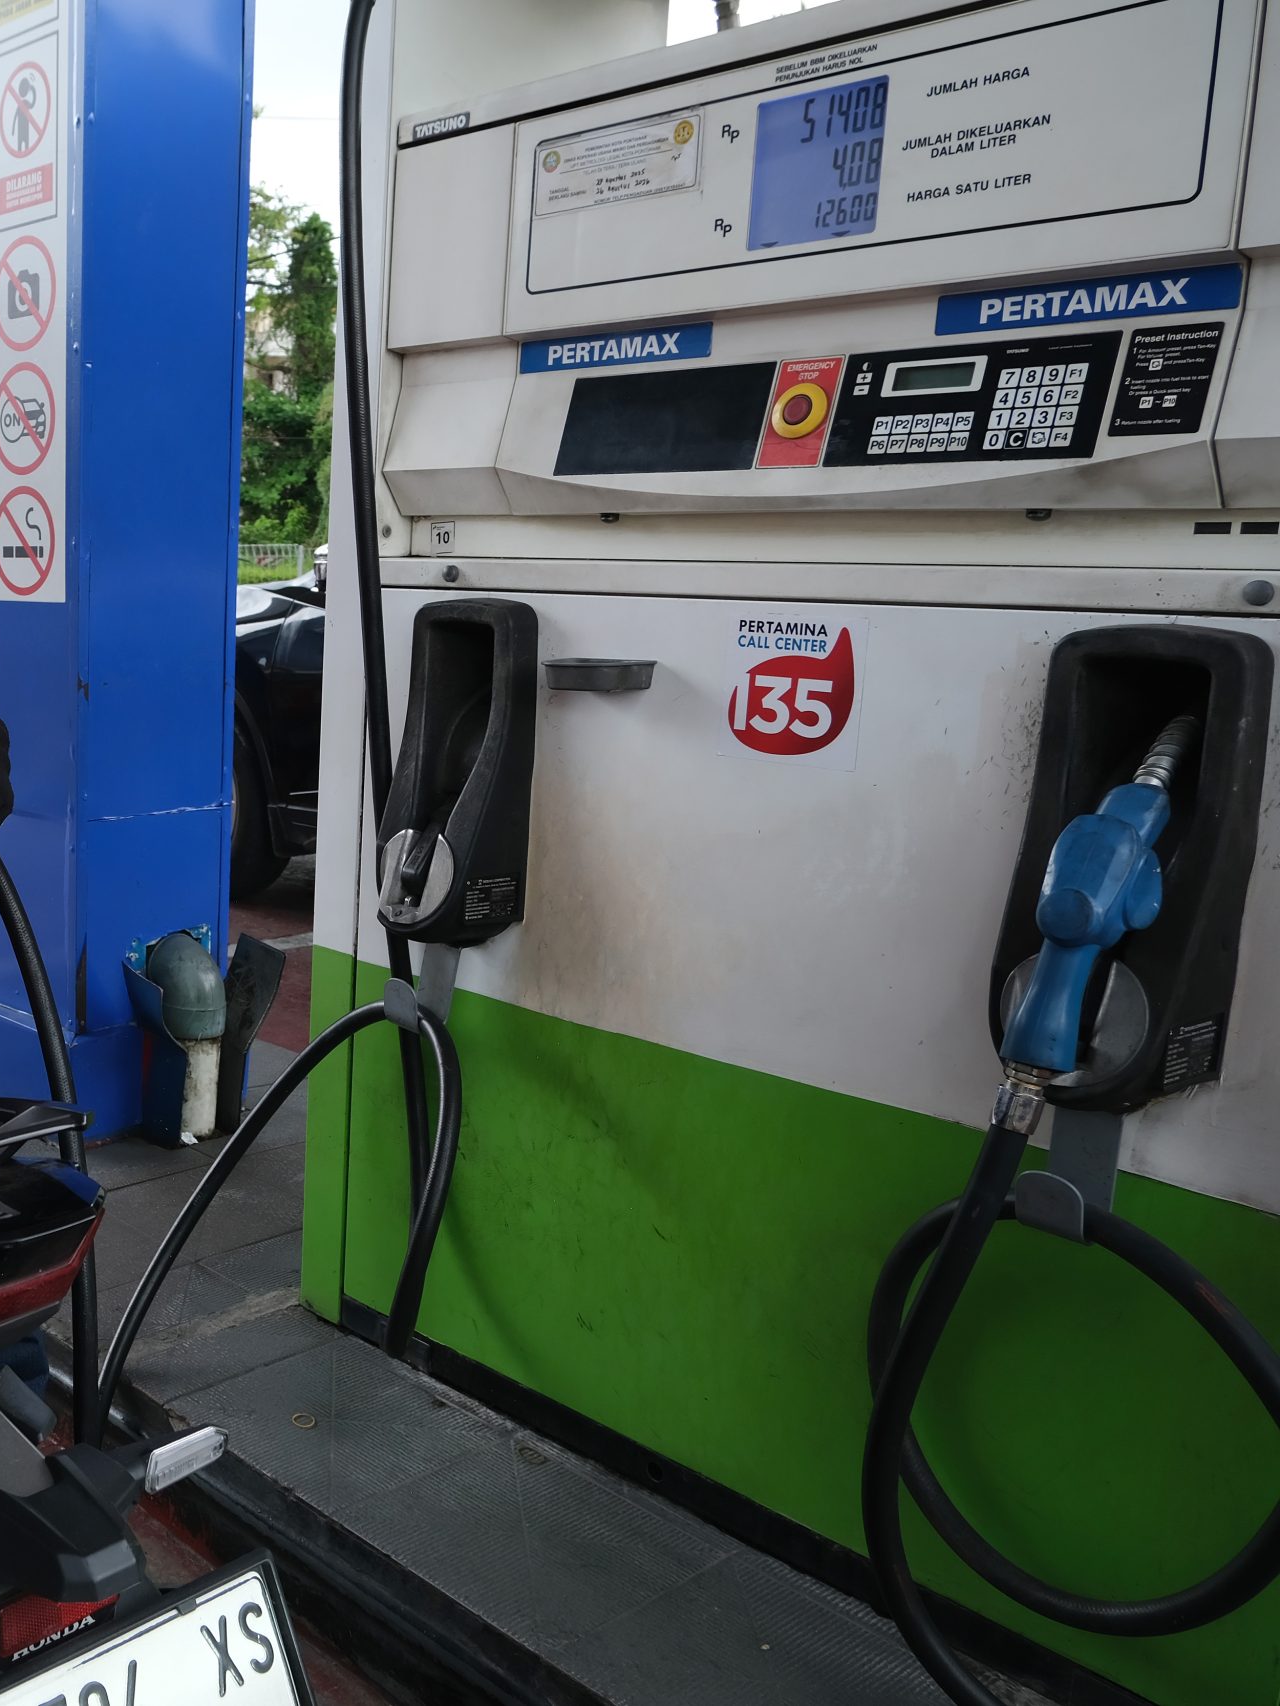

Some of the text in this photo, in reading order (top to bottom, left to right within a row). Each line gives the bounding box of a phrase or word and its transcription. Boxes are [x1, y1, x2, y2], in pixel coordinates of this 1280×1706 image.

[775, 57, 863, 82] PENUNJUKAN HARUS NOL
[776, 44, 878, 74] SEBELUM BBM DIKELUARKAN
[926, 67, 1030, 97] JUMLAH HARGA
[800, 82, 889, 143] 51408
[415, 115, 467, 138] TATSUNO
[721, 124, 740, 143] Rp
[902, 114, 1051, 151] JUMLAH DIKELUARKAN
[930, 134, 1016, 158] DALAM LITER
[6, 170, 43, 194] DILARANG
[906, 173, 1031, 203] HARGA SATU LITER
[815, 192, 878, 229] 12600
[714, 218, 732, 237] Rp
[979, 277, 1191, 325] PERTAMAX
[1135, 329, 1219, 343] Preset Instruction
[547, 332, 680, 366] PERTAMAX
[787, 360, 836, 372] EMERGENCY
[798, 371, 820, 381] STOP
[1005, 368, 1083, 385] 7 8 9 F1
[999, 389, 1079, 405] 4 5 6 F2
[4, 413, 21, 428] ON
[875, 415, 971, 431] P1 P2 P3 P4 P5
[995, 410, 1073, 426] 1 2 3 F3
[870, 436, 968, 450] P6 P7 P8 P9 P10
[988, 432, 1068, 447] 0 C F4
[436, 531, 450, 544] 10
[739, 620, 828, 637] PERTAMINA
[738, 635, 827, 653] CALL CENTER
[733, 672, 833, 739] 135
[11, 1613, 97, 1661] HONDA
[200, 1602, 275, 1698] XS
